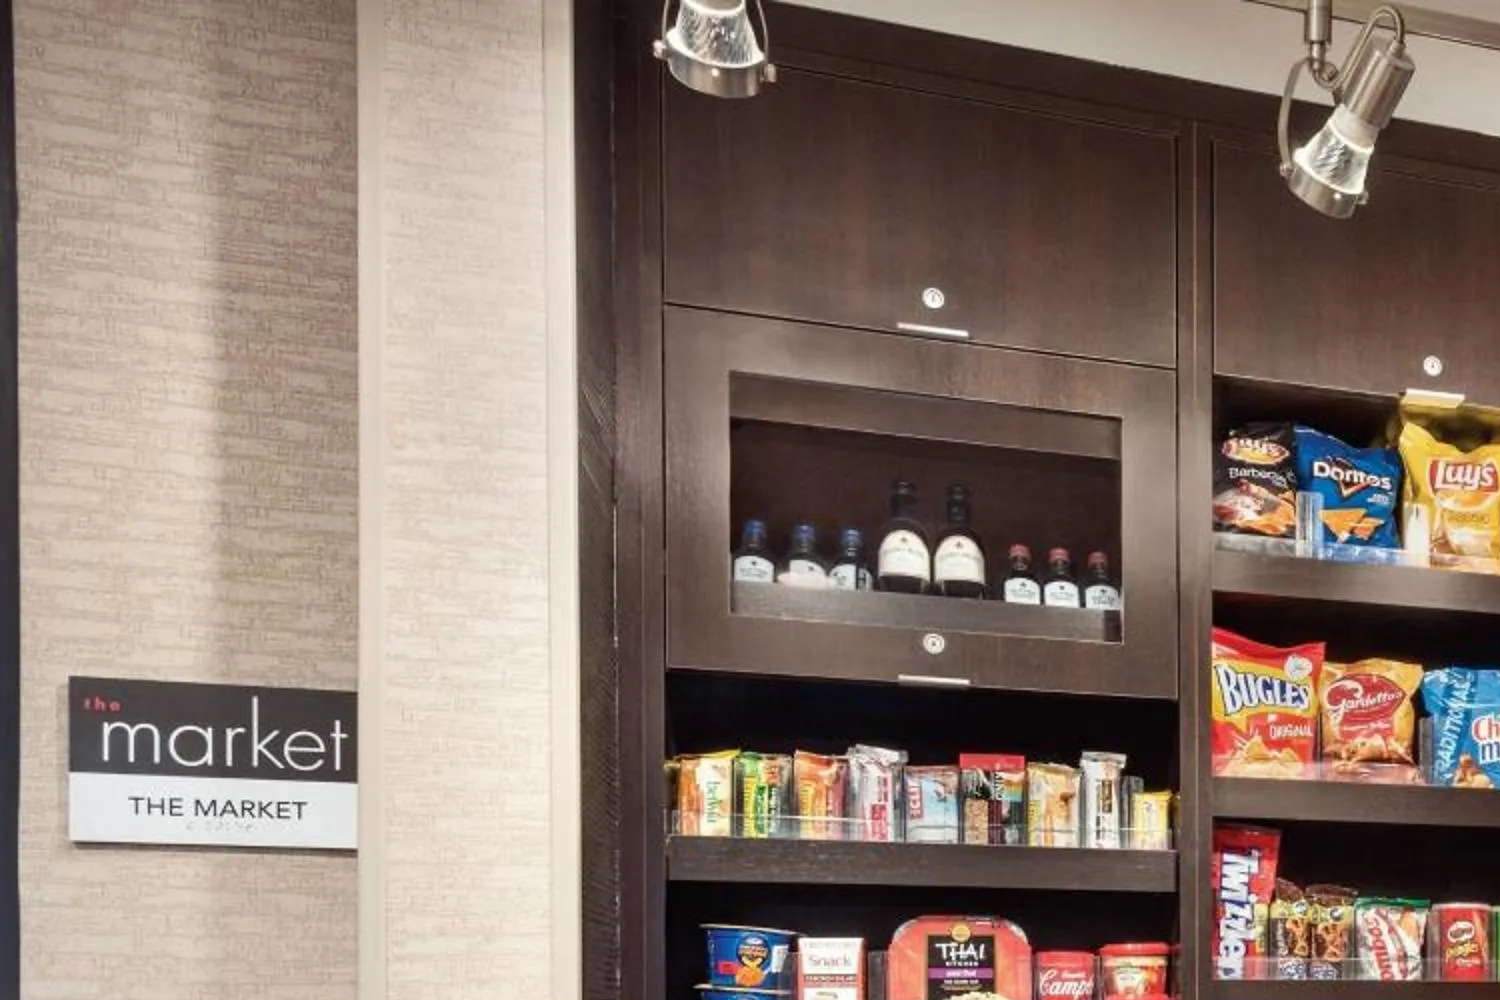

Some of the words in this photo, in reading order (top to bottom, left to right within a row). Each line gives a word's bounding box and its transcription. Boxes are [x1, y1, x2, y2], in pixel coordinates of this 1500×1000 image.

[1313, 460, 1392, 490] Doritos
[1434, 460, 1495, 491] Lay's
[84, 696, 121, 712] the
[1216, 664, 1310, 716] BUGLES
[102, 695, 349, 772] market
[128, 796, 184, 817] THE
[194, 798, 308, 820] MARKET
[1219, 848, 1260, 981] Twizzler
[935, 943, 985, 960] THAI
[1367, 914, 1393, 981] ombos
